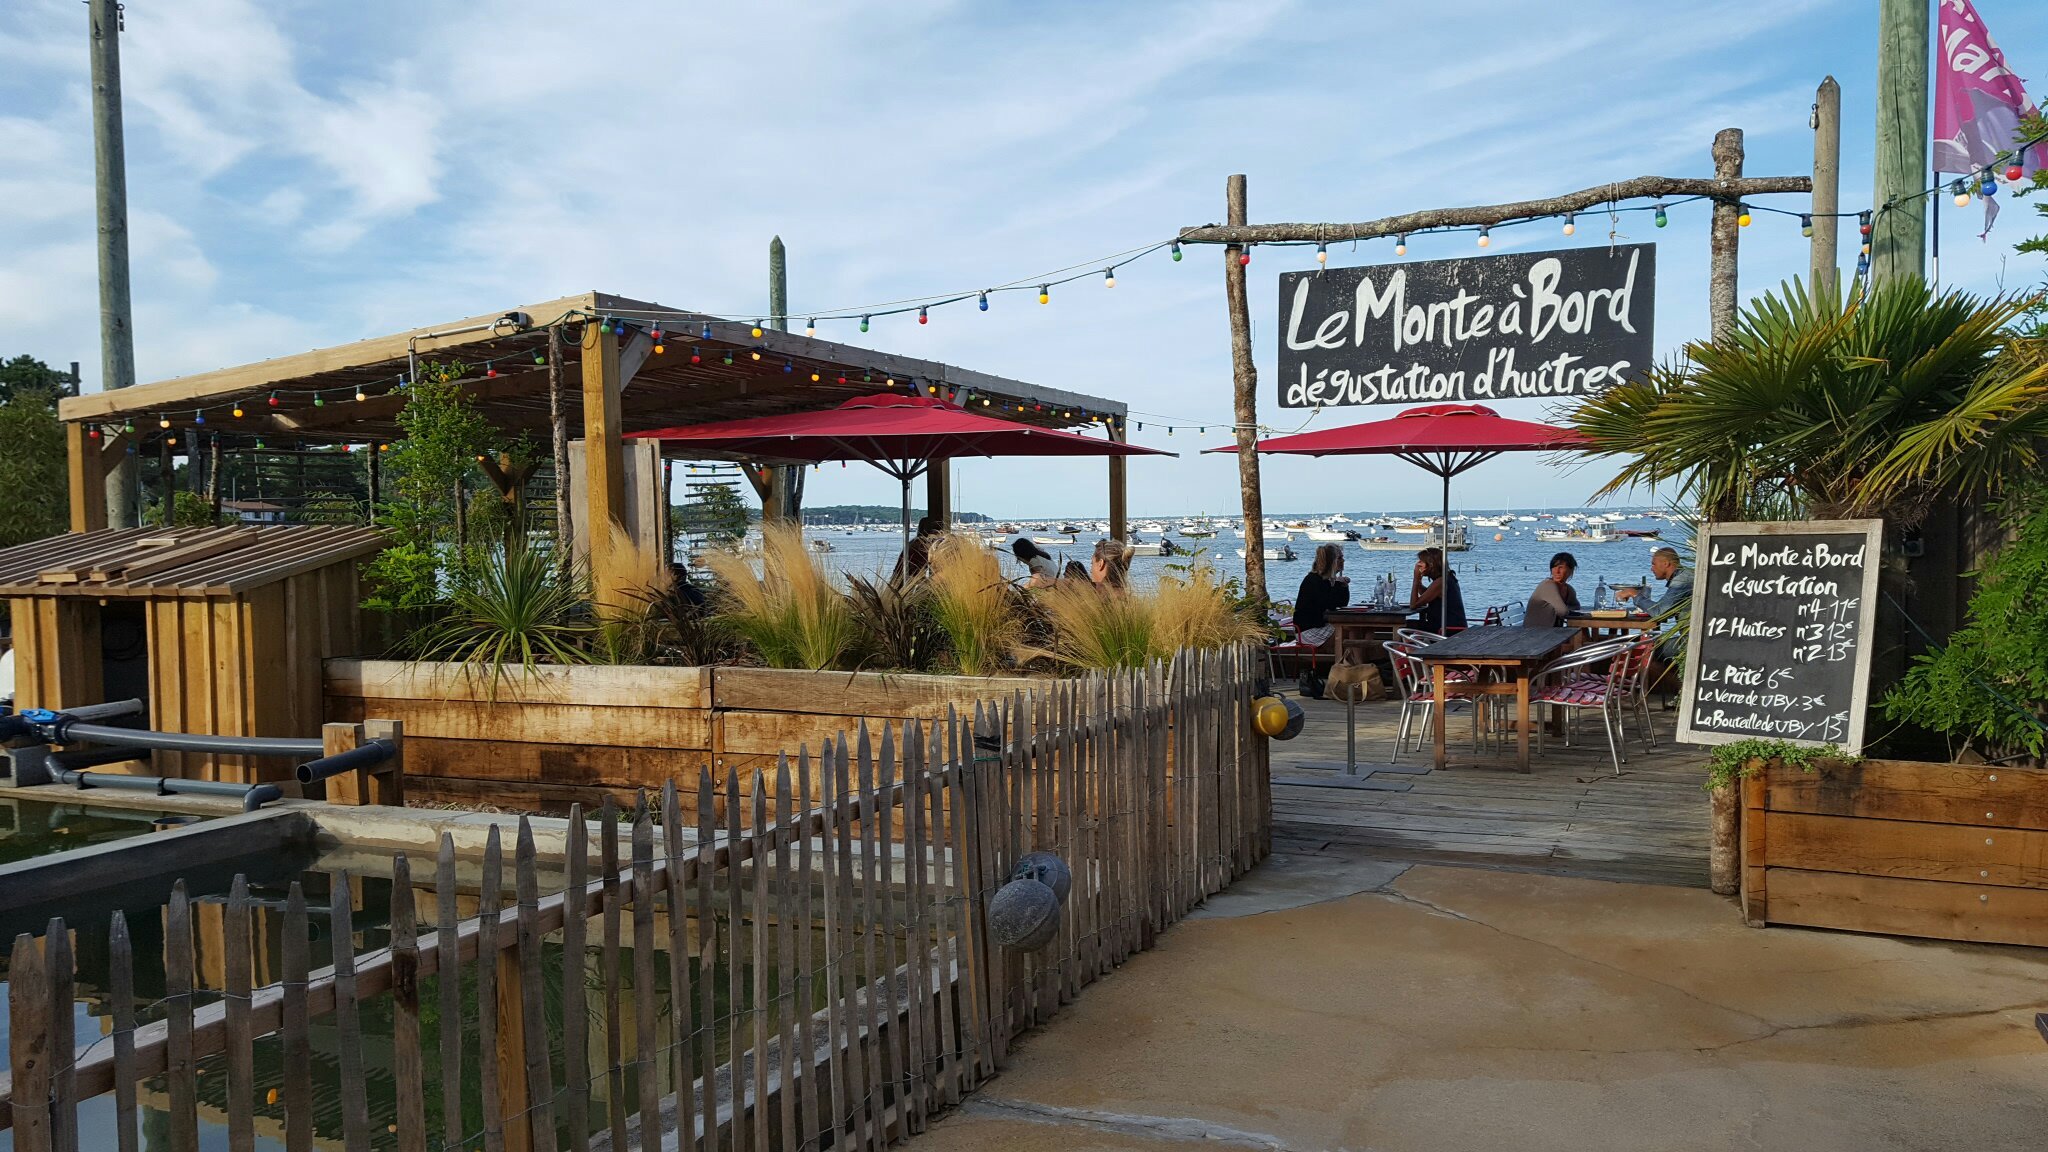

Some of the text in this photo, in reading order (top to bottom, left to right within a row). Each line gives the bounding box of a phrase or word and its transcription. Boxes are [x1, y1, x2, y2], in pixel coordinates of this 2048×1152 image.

[1286, 247, 1640, 352] Le Monte à Bord
[1287, 347, 1631, 406] dégustation d'huîtres
[1711, 542, 1866, 569] Le Monte à Bord
[1721, 570, 1839, 598] dégustation
[1830, 597, 1860, 621] 11€
[1708, 617, 1731, 637] 12
[1826, 621, 1854, 641] 12€
[1827, 639, 1856, 661] 13€
[1701, 664, 1795, 689] Le Pâté 6€
[1698, 687, 1713, 701] Le
[1715, 688, 1745, 703] Verre
[1745, 690, 1759, 706] de
[1802, 694, 1827, 711] 3€
[1696, 708, 1712, 726] La
[1761, 714, 1774, 732] de
[1775, 721, 1814, 738] UBY
[1817, 711, 1849, 740] 13€
